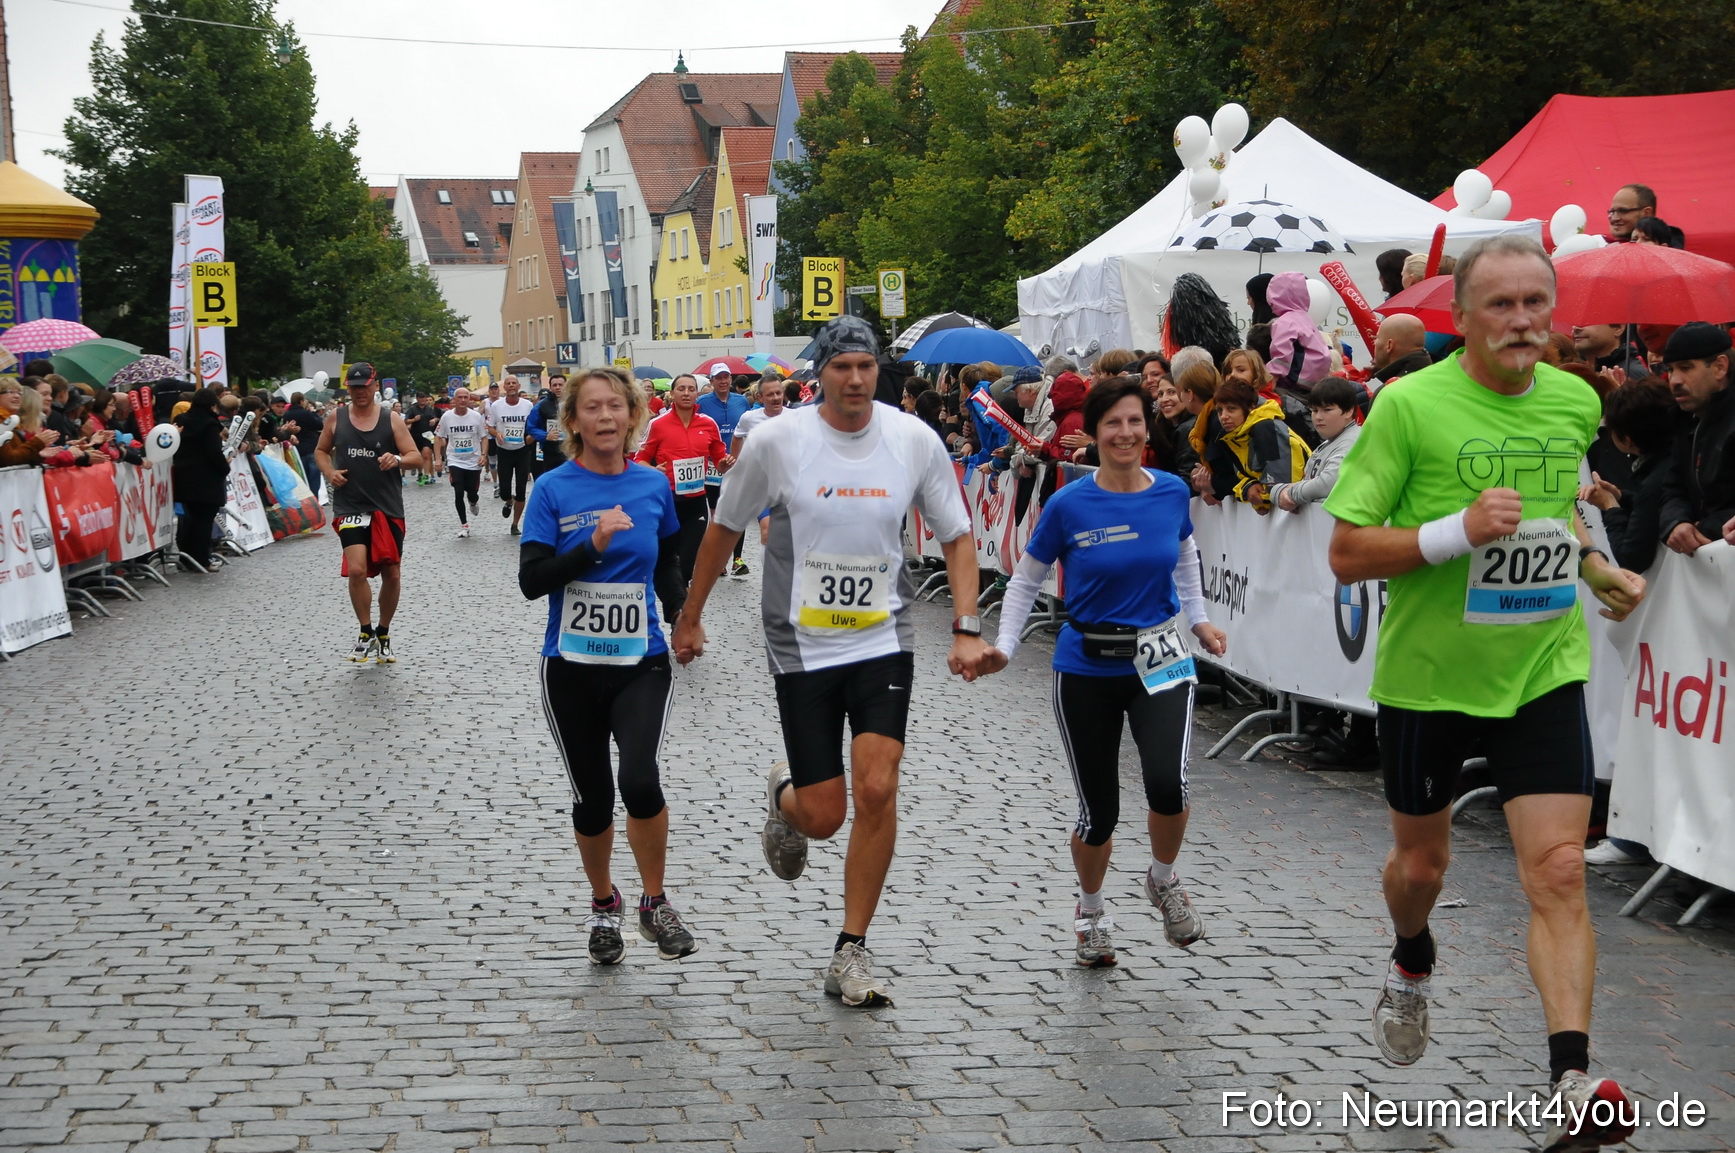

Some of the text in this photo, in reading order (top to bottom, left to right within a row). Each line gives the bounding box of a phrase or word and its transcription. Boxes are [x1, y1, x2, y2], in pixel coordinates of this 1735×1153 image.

[196, 265, 230, 277] Block
[808, 260, 840, 272] Block
[677, 276, 691, 291] HOTEL
[203, 282, 226, 313] B
[814, 277, 834, 307] B
[501, 415, 525, 423] THULE
[449, 425, 474, 433] THULE
[505, 429, 523, 437] 2427
[455, 439, 472, 448] 2428
[347, 446, 375, 458] igeko
[678, 465, 703, 481] 3017
[837, 488, 891, 498] KLEBL
[805, 560, 876, 572] PARTL Neumarkt
[1481, 542, 1571, 585] 2022
[567, 587, 634, 600] PARTL Neumarkt
[819, 575, 873, 606] 392
[1499, 595, 1551, 610] Werner
[570, 601, 640, 633] 2500
[831, 614, 857, 626] Uwe
[587, 640, 620, 655] Helga
[1634, 642, 1727, 744] Audi
